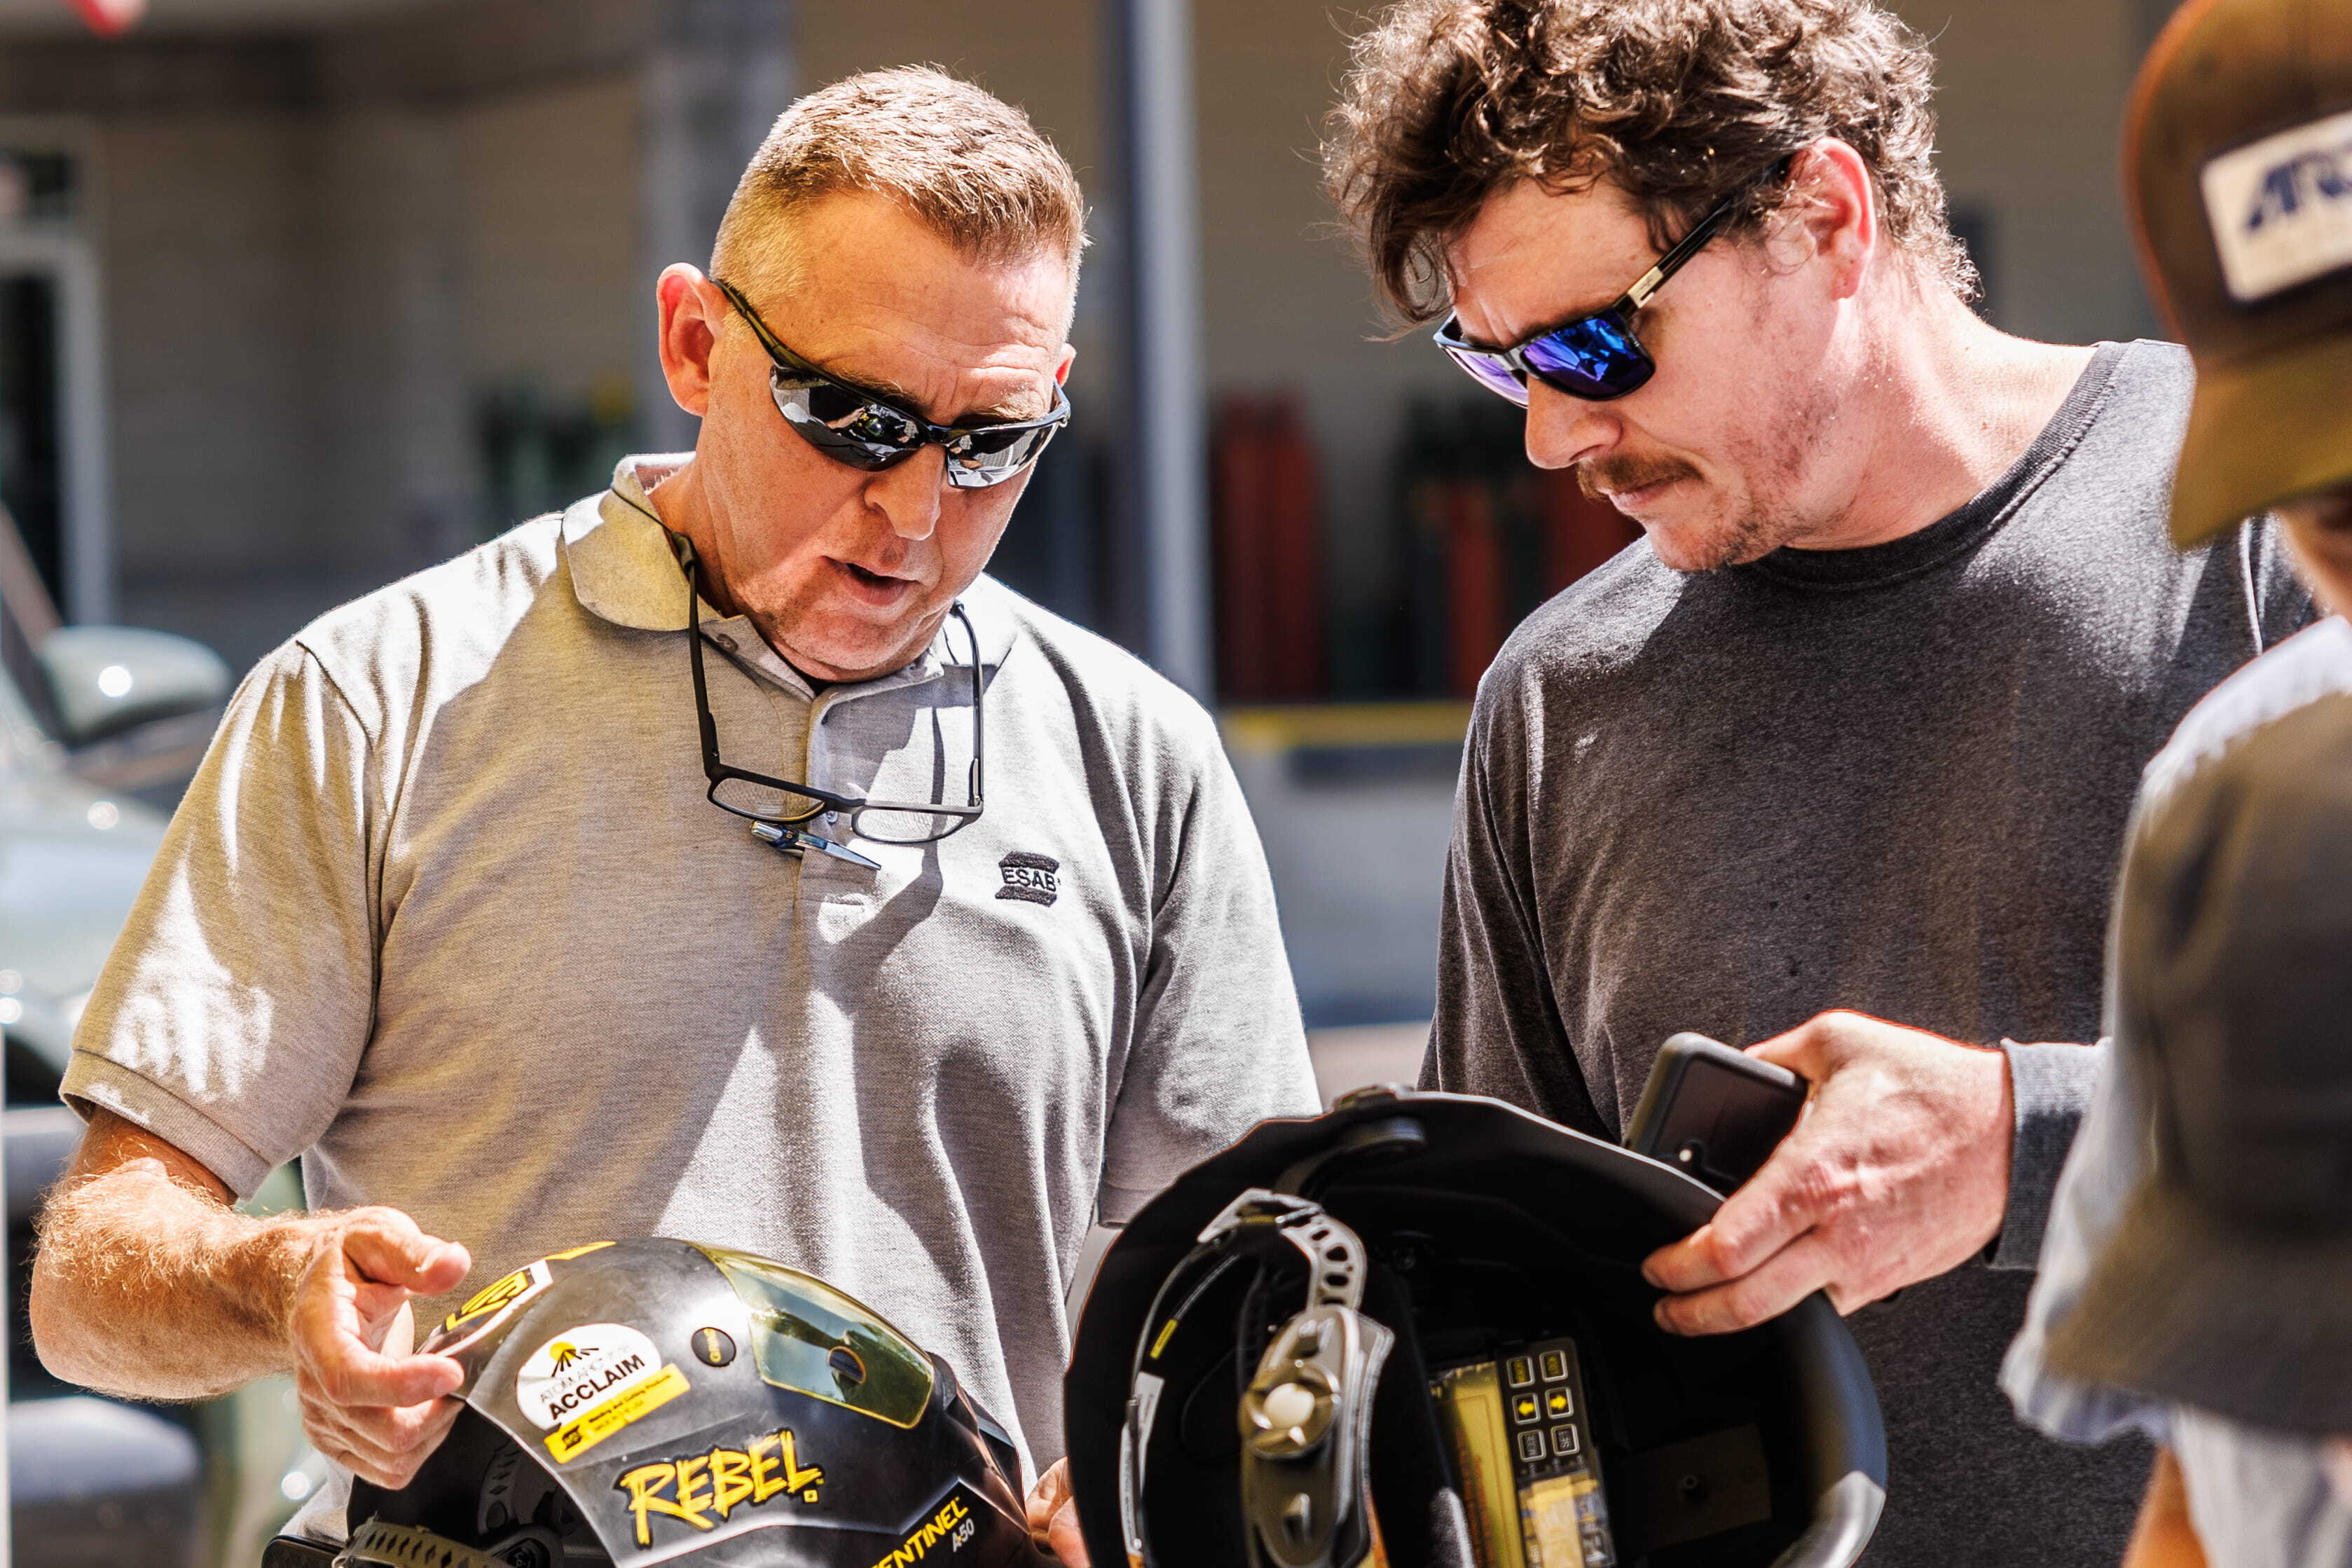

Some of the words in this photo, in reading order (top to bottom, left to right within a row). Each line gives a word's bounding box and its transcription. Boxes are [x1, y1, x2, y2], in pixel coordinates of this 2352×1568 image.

[1001, 868, 1057, 892] ESAB
[549, 1354, 645, 1420] ACCLAIM
[619, 1430, 823, 1545] REBEL
[871, 1499, 969, 1568] ENTINEL
[951, 1518, 975, 1553] A50
